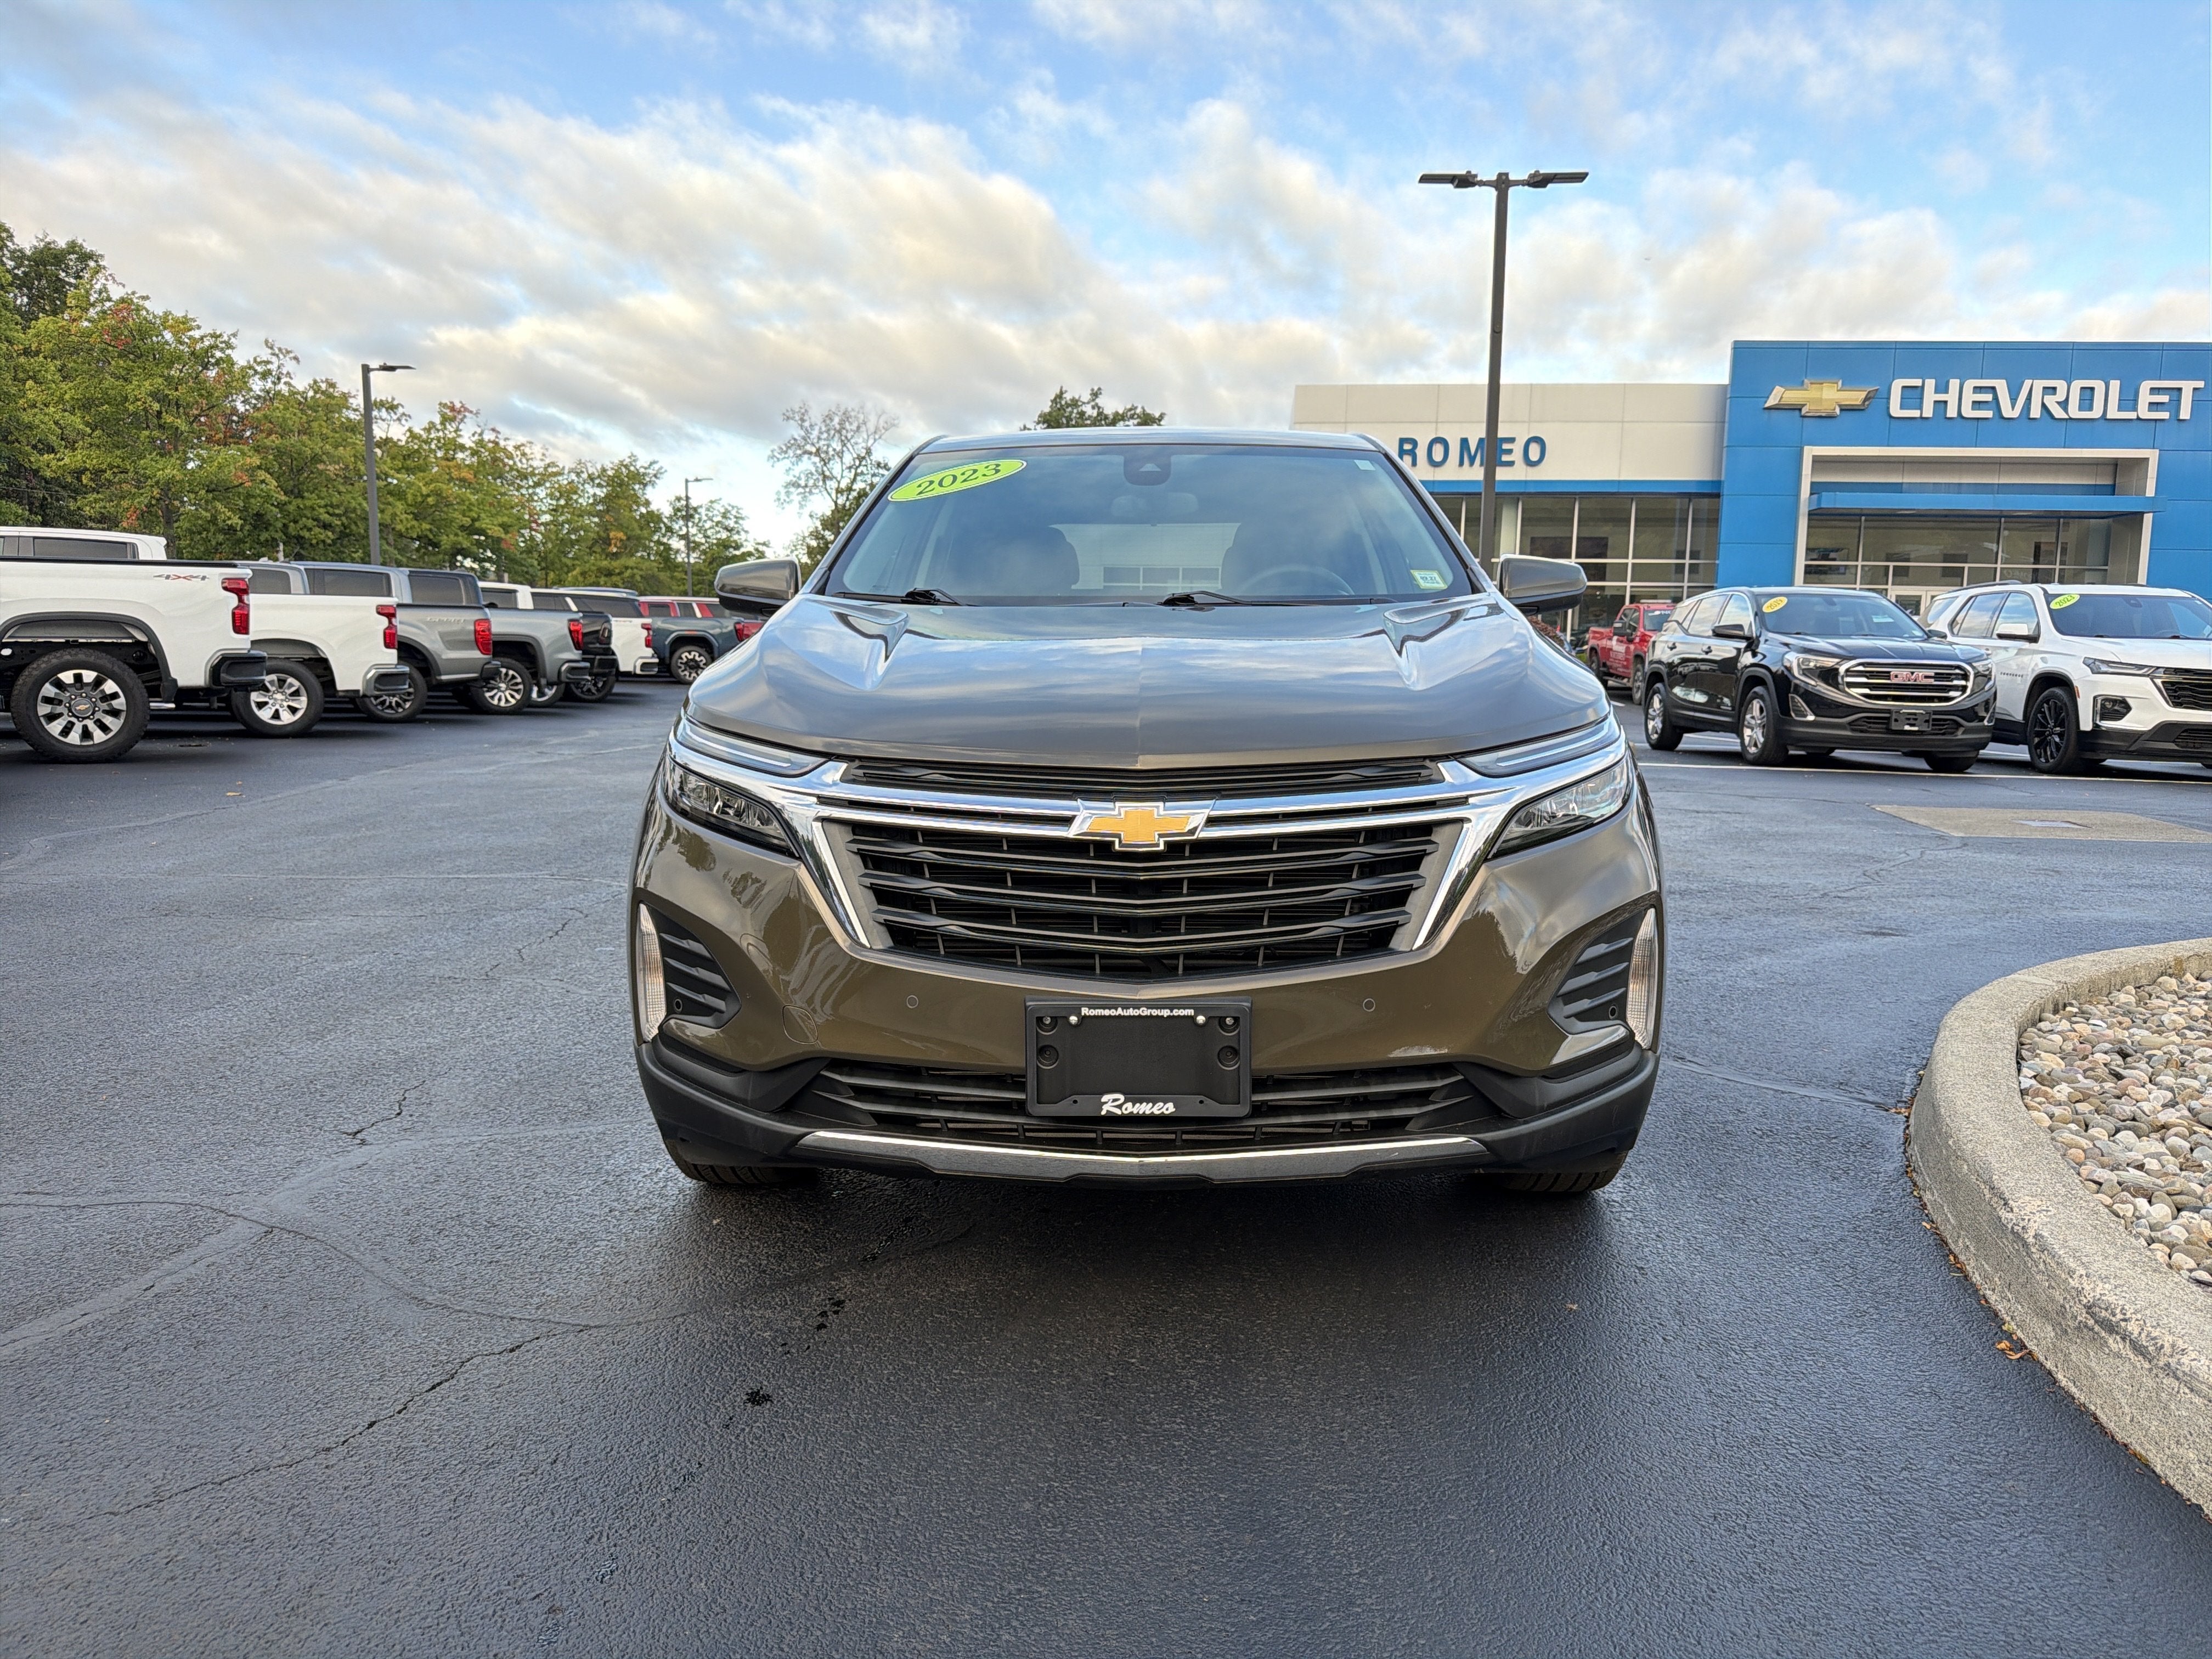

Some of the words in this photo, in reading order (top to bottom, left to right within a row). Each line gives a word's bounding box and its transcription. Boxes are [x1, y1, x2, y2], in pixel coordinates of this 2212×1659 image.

[1888, 378, 2205, 420] CHEVROLET
[1397, 436, 1547, 467] ROMEO
[916, 463, 1002, 496] 2023
[2055, 595, 2075, 607] 2023
[1890, 671, 1935, 682] GMC
[1081, 1007, 1194, 1017] RomeoAutoGroup.com
[1100, 1093, 1176, 1116] Romeo
